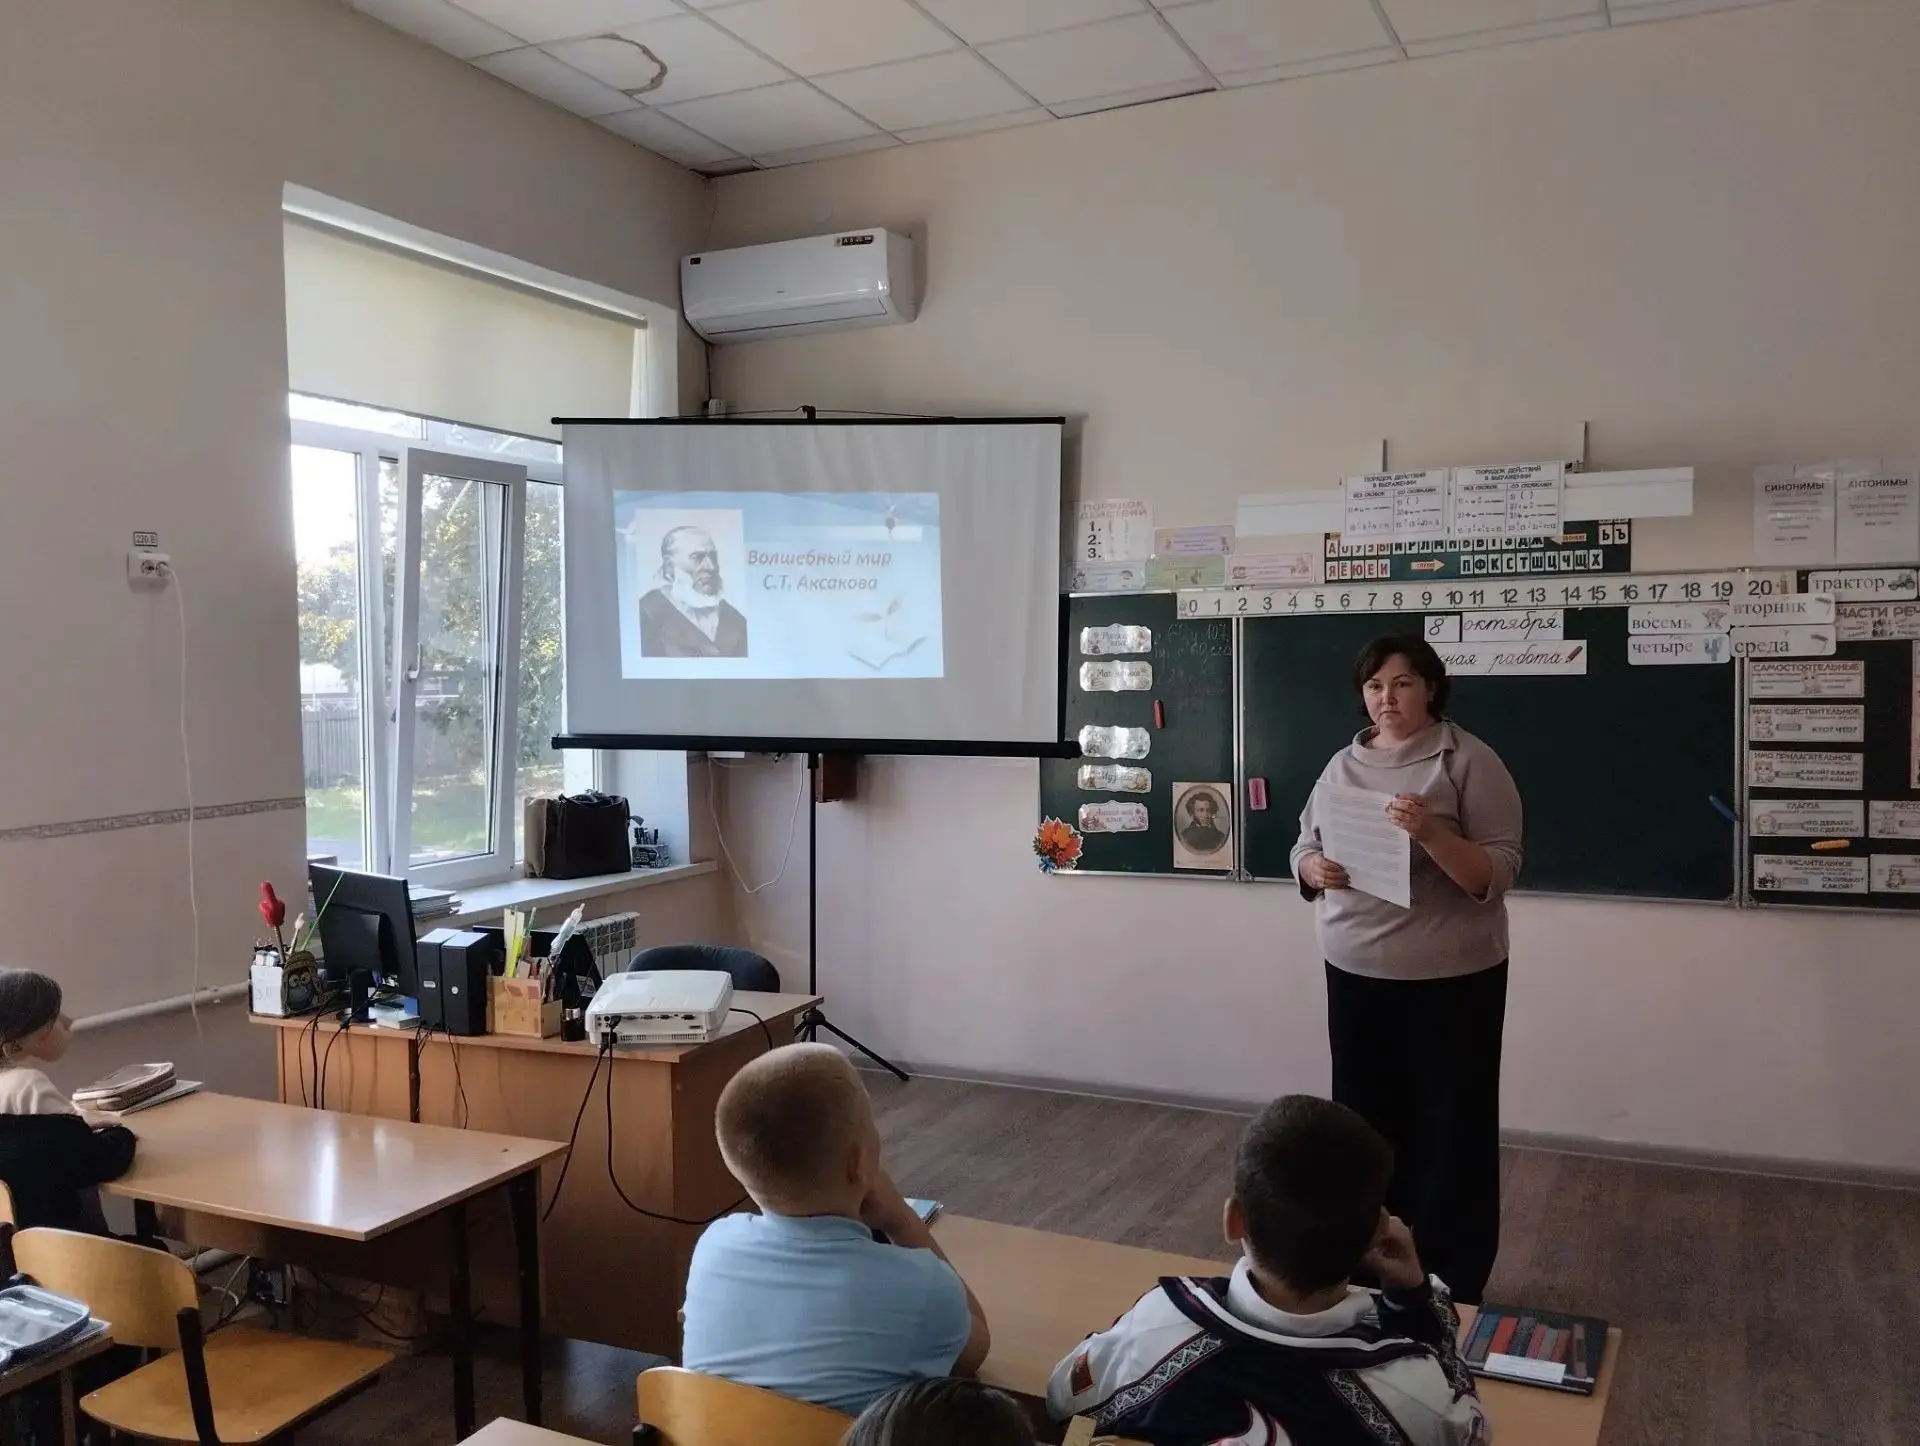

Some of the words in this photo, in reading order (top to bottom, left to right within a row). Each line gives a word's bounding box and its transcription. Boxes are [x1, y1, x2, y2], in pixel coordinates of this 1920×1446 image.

[1764, 482, 1825, 493] СИНОНИМЫ
[1848, 478, 1908, 490] АНТОНИМЫ
[748, 549, 850, 565] Волшебный
[856, 551, 891, 571] мир
[797, 575, 878, 590] Аксакова
[1812, 577, 1885, 592] трактор
[1189, 600, 1198, 612] 0
[1215, 600, 1221, 612] 1
[1238, 598, 1248, 611] 2
[1263, 597, 1272, 610] 3
[1288, 595, 1298, 610] 4
[1315, 595, 1324, 608] 5
[1340, 594, 1350, 608] 6
[1368, 593, 1378, 607] 7
[1392, 592, 1403, 606] 8
[1421, 591, 1432, 605] 9
[1446, 590, 1463, 604] 10
[1469, 590, 1484, 604] 11
[1500, 589, 1518, 603] 12
[1527, 588, 1546, 602] 13
[1561, 586, 1581, 601] 14
[1587, 585, 1606, 600] 15
[1620, 584, 1638, 599] 16
[1648, 584, 1668, 599] 17
[1680, 583, 1700, 598] 18
[1711, 581, 1733, 597] 19
[1748, 580, 1772, 595] 20
[1733, 601, 1807, 617] вторник
[1429, 616, 1444, 636] 8
[1632, 615, 1691, 630] восемь
[1632, 641, 1693, 656] четыре
[1734, 639, 1789, 657] среда
